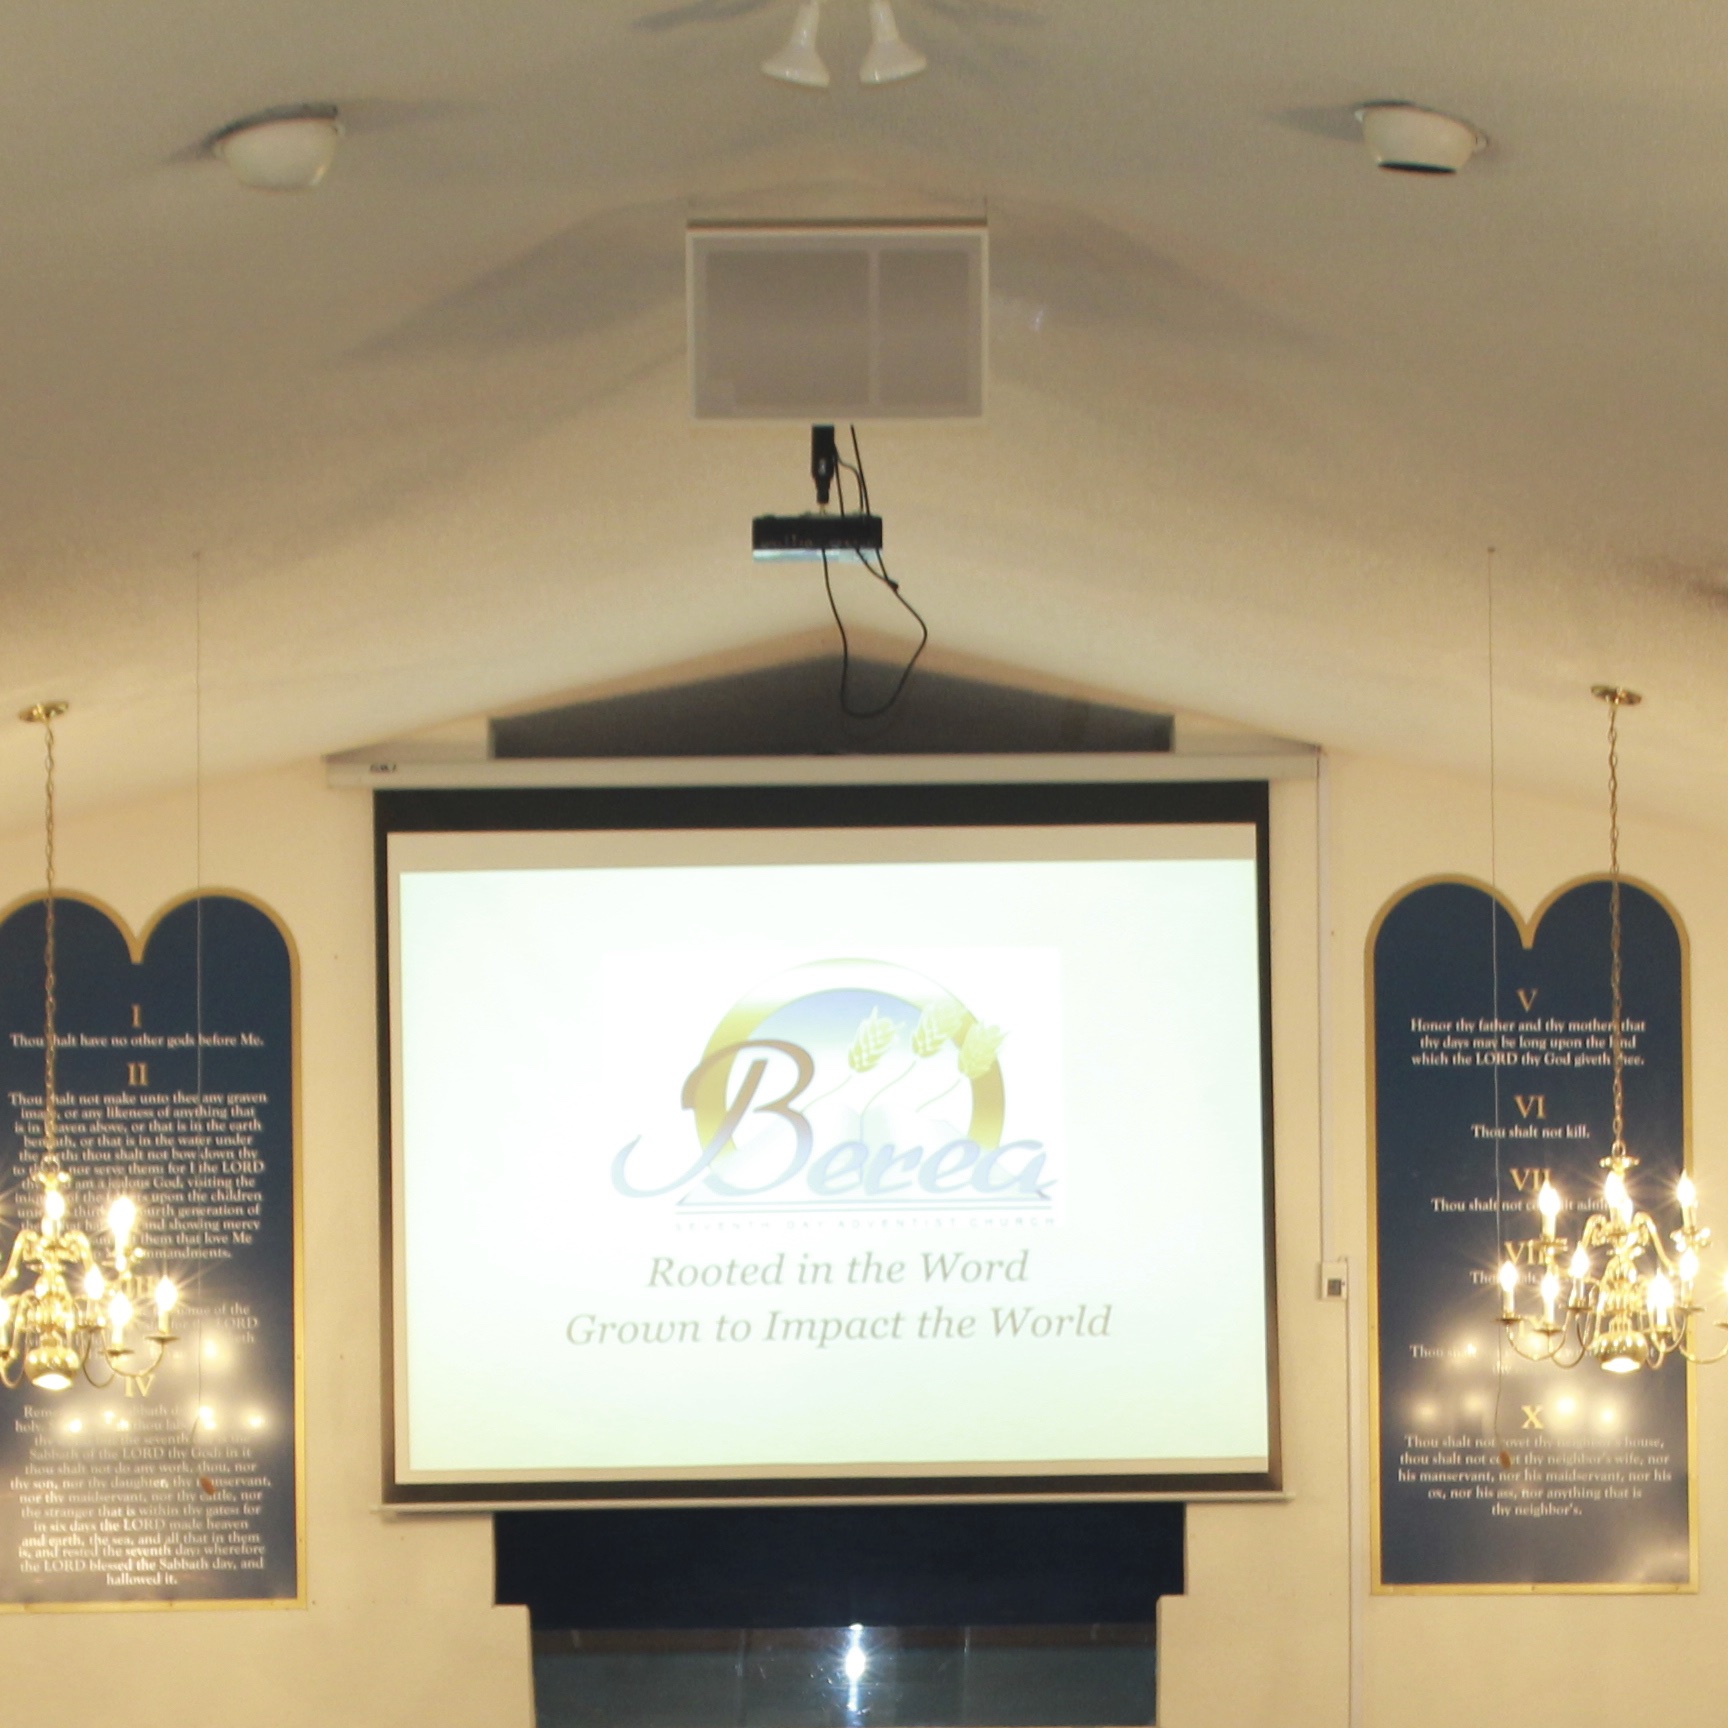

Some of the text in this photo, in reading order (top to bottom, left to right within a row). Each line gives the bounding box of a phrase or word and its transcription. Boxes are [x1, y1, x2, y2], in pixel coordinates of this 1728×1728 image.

[1517, 988, 1538, 1012] V
[131, 1004, 142, 1028] I
[1411, 1018, 1451, 1031] Honor
[1456, 1018, 1474, 1033] thy
[1479, 1018, 1515, 1031] father
[1519, 1018, 1541, 1031] and
[1546, 1018, 1564, 1033] thy
[1621, 1018, 1645, 1031] that
[10, 1033, 264, 1049] Thou halt have no other gods before Me.
[1420, 1035, 1636, 1050] thy days may be long upon the lnd
[1411, 1052, 1644, 1067] which the LORD thy God giveth hee.
[128, 1062, 148, 1086] II
[8, 1091, 267, 1106] Thou halt not make unto thee any graven
[65, 1105, 255, 1121] or any likeness of anything that
[1515, 1095, 1546, 1119] VI
[15, 1120, 261, 1134] is in eaven above, or that is in the earth
[610, 1038, 1058, 1201] Berea
[1471, 1124, 1590, 1138] Thou shalt not kill.
[80, 1137, 93, 1147] or
[97, 1135, 122, 1147] that
[126, 1135, 136, 1147] is
[139, 1135, 151, 1146] in
[155, 1134, 175, 1146] the
[178, 1135, 212, 1146] water
[215, 1134, 253, 1146] under
[82, 1149, 111, 1162] thou
[115, 1149, 141, 1161] shalt
[148, 1150, 167, 1161] not
[198, 1148, 234, 1160] down
[238, 1148, 258, 1161] thy
[1431, 1198, 1465, 1212] Thou
[1469, 1198, 1498, 1212] shalt
[1502, 1199, 1522, 1212] not
[1526, 1198, 1573, 1211] coit
[787, 1220, 824, 1231] DAY
[838, 1217, 956, 1229] ADVENTIST
[970, 1217, 1055, 1228] CHURCH
[647, 1250, 1030, 1288] Rooted in the Word
[566, 1305, 1113, 1349] Grown to Impact the World
[125, 1374, 154, 1397] IV
[1522, 1406, 1544, 1429] X
[1404, 1436, 1438, 1448] Thou
[1443, 1436, 1470, 1448] shalt
[1475, 1437, 1496, 1448] not
[1535, 1435, 1550, 1449] thy
[1625, 1436, 1664, 1449] house,
[1400, 1452, 1669, 1467] thou shalt not coet thy neighbor's wife, nor
[1398, 1467, 1671, 1482] his manservant, nor his maidservant, nor his
[1428, 1486, 1642, 1500] ox, nor his ass, nor anything that is
[1492, 1502, 1582, 1517] thy neighbor's.
[21, 1557, 263, 1572] the LORD blessed the Sabbath day, and
[107, 1572, 178, 1585] hallowed it.
